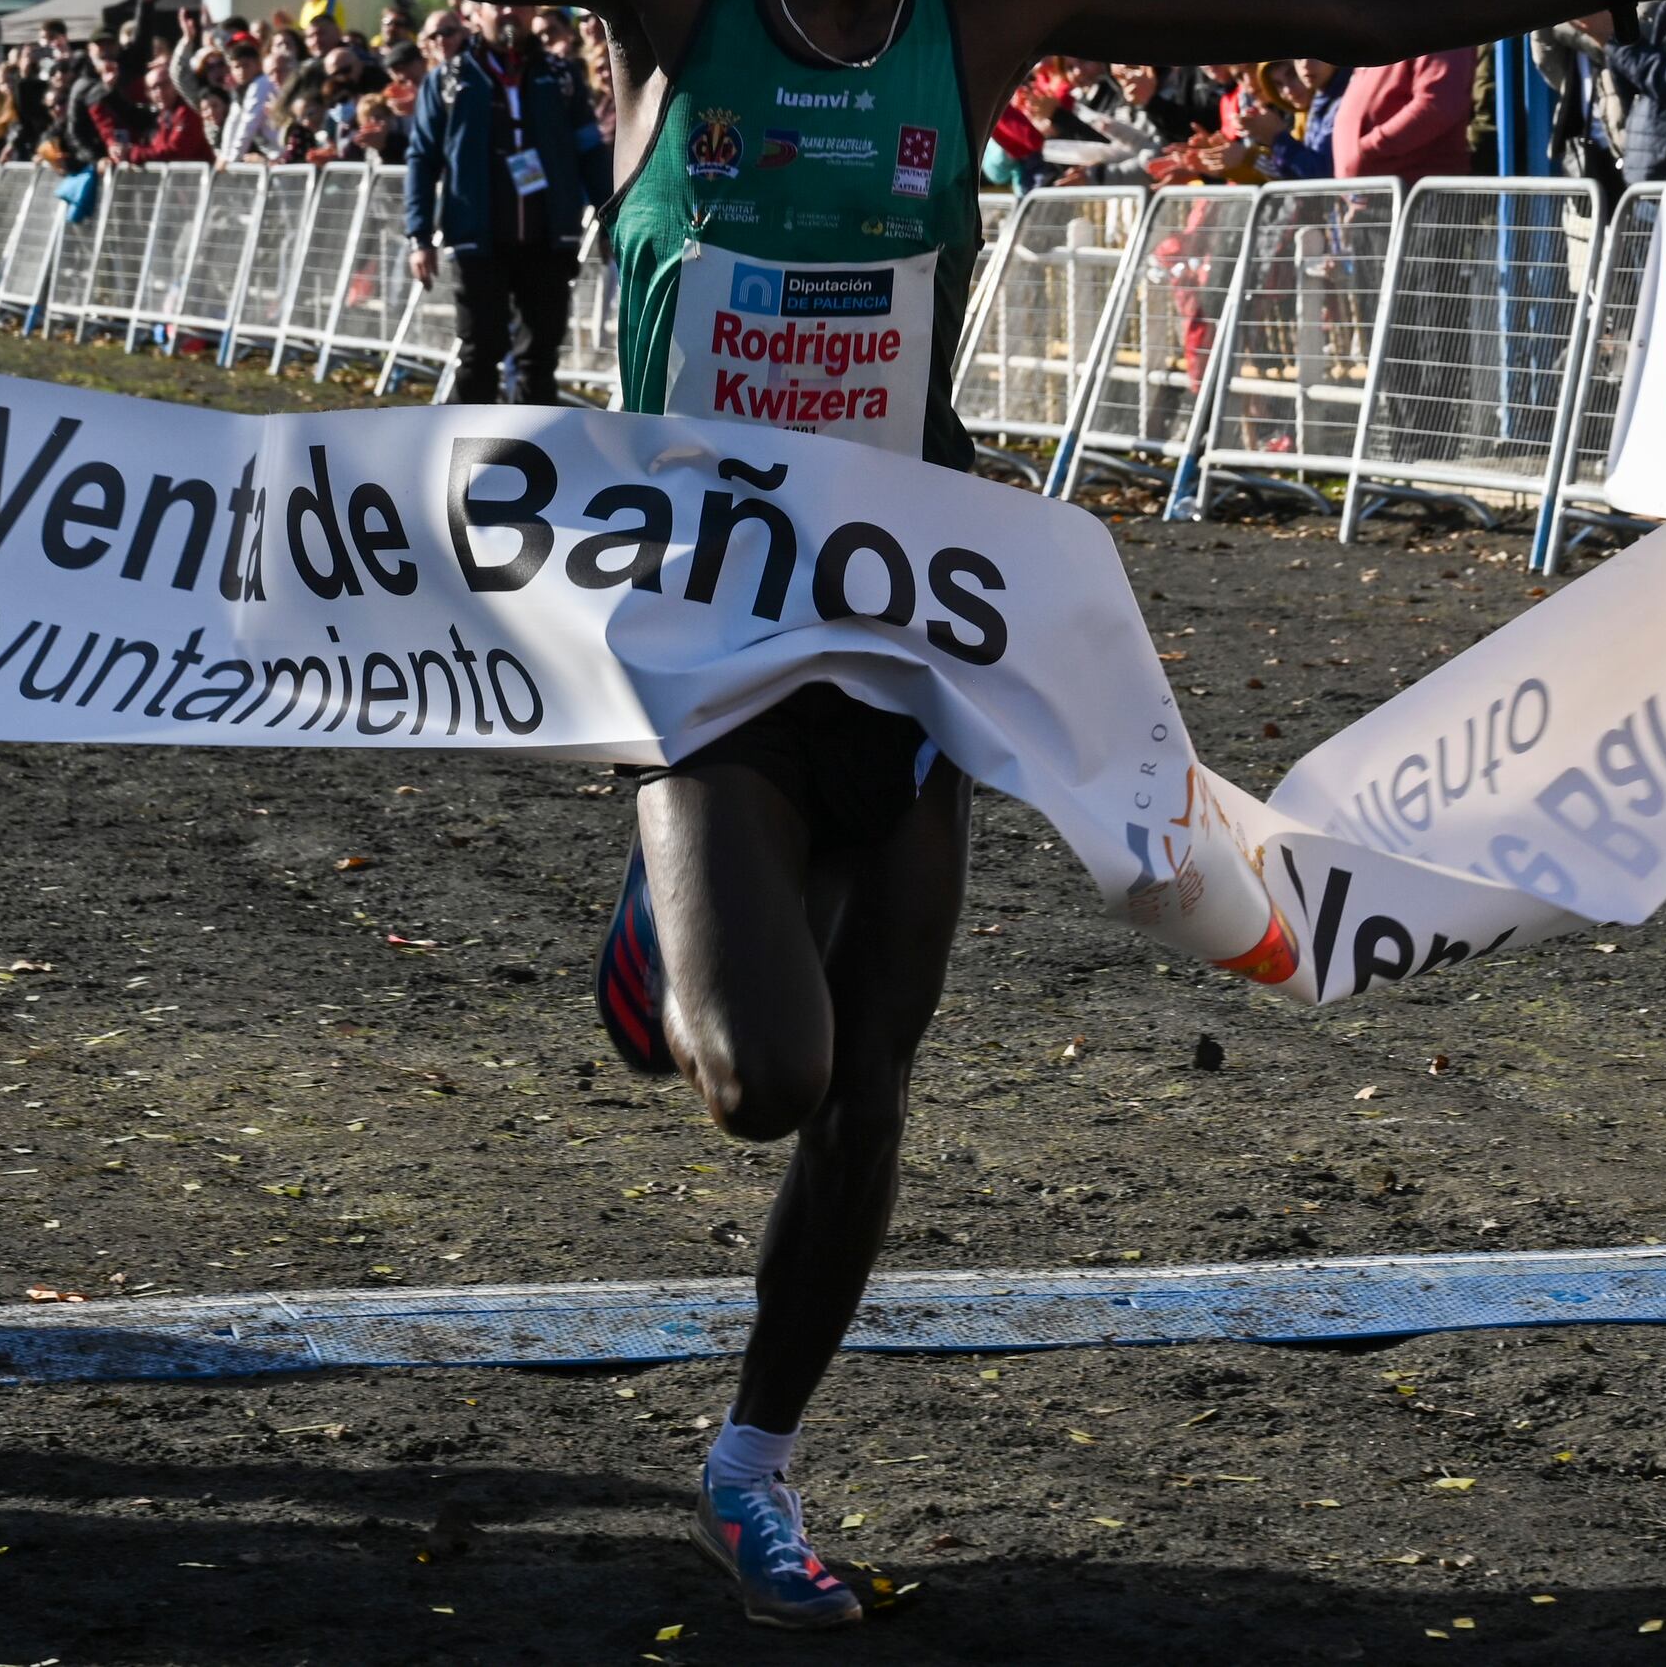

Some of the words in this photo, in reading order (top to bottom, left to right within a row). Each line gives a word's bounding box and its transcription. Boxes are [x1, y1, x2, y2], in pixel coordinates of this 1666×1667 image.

[776, 87, 849, 109] luanvi
[886, 221, 923, 233] TRINIDAD
[789, 278, 872, 293] Diputación
[787, 297, 808, 310] DE
[813, 295, 888, 310] PALENCIA
[712, 310, 901, 377] Rodrigue
[714, 370, 888, 422] Kwizera
[286, 445, 418, 598] de
[447, 437, 1007, 666] Baños
